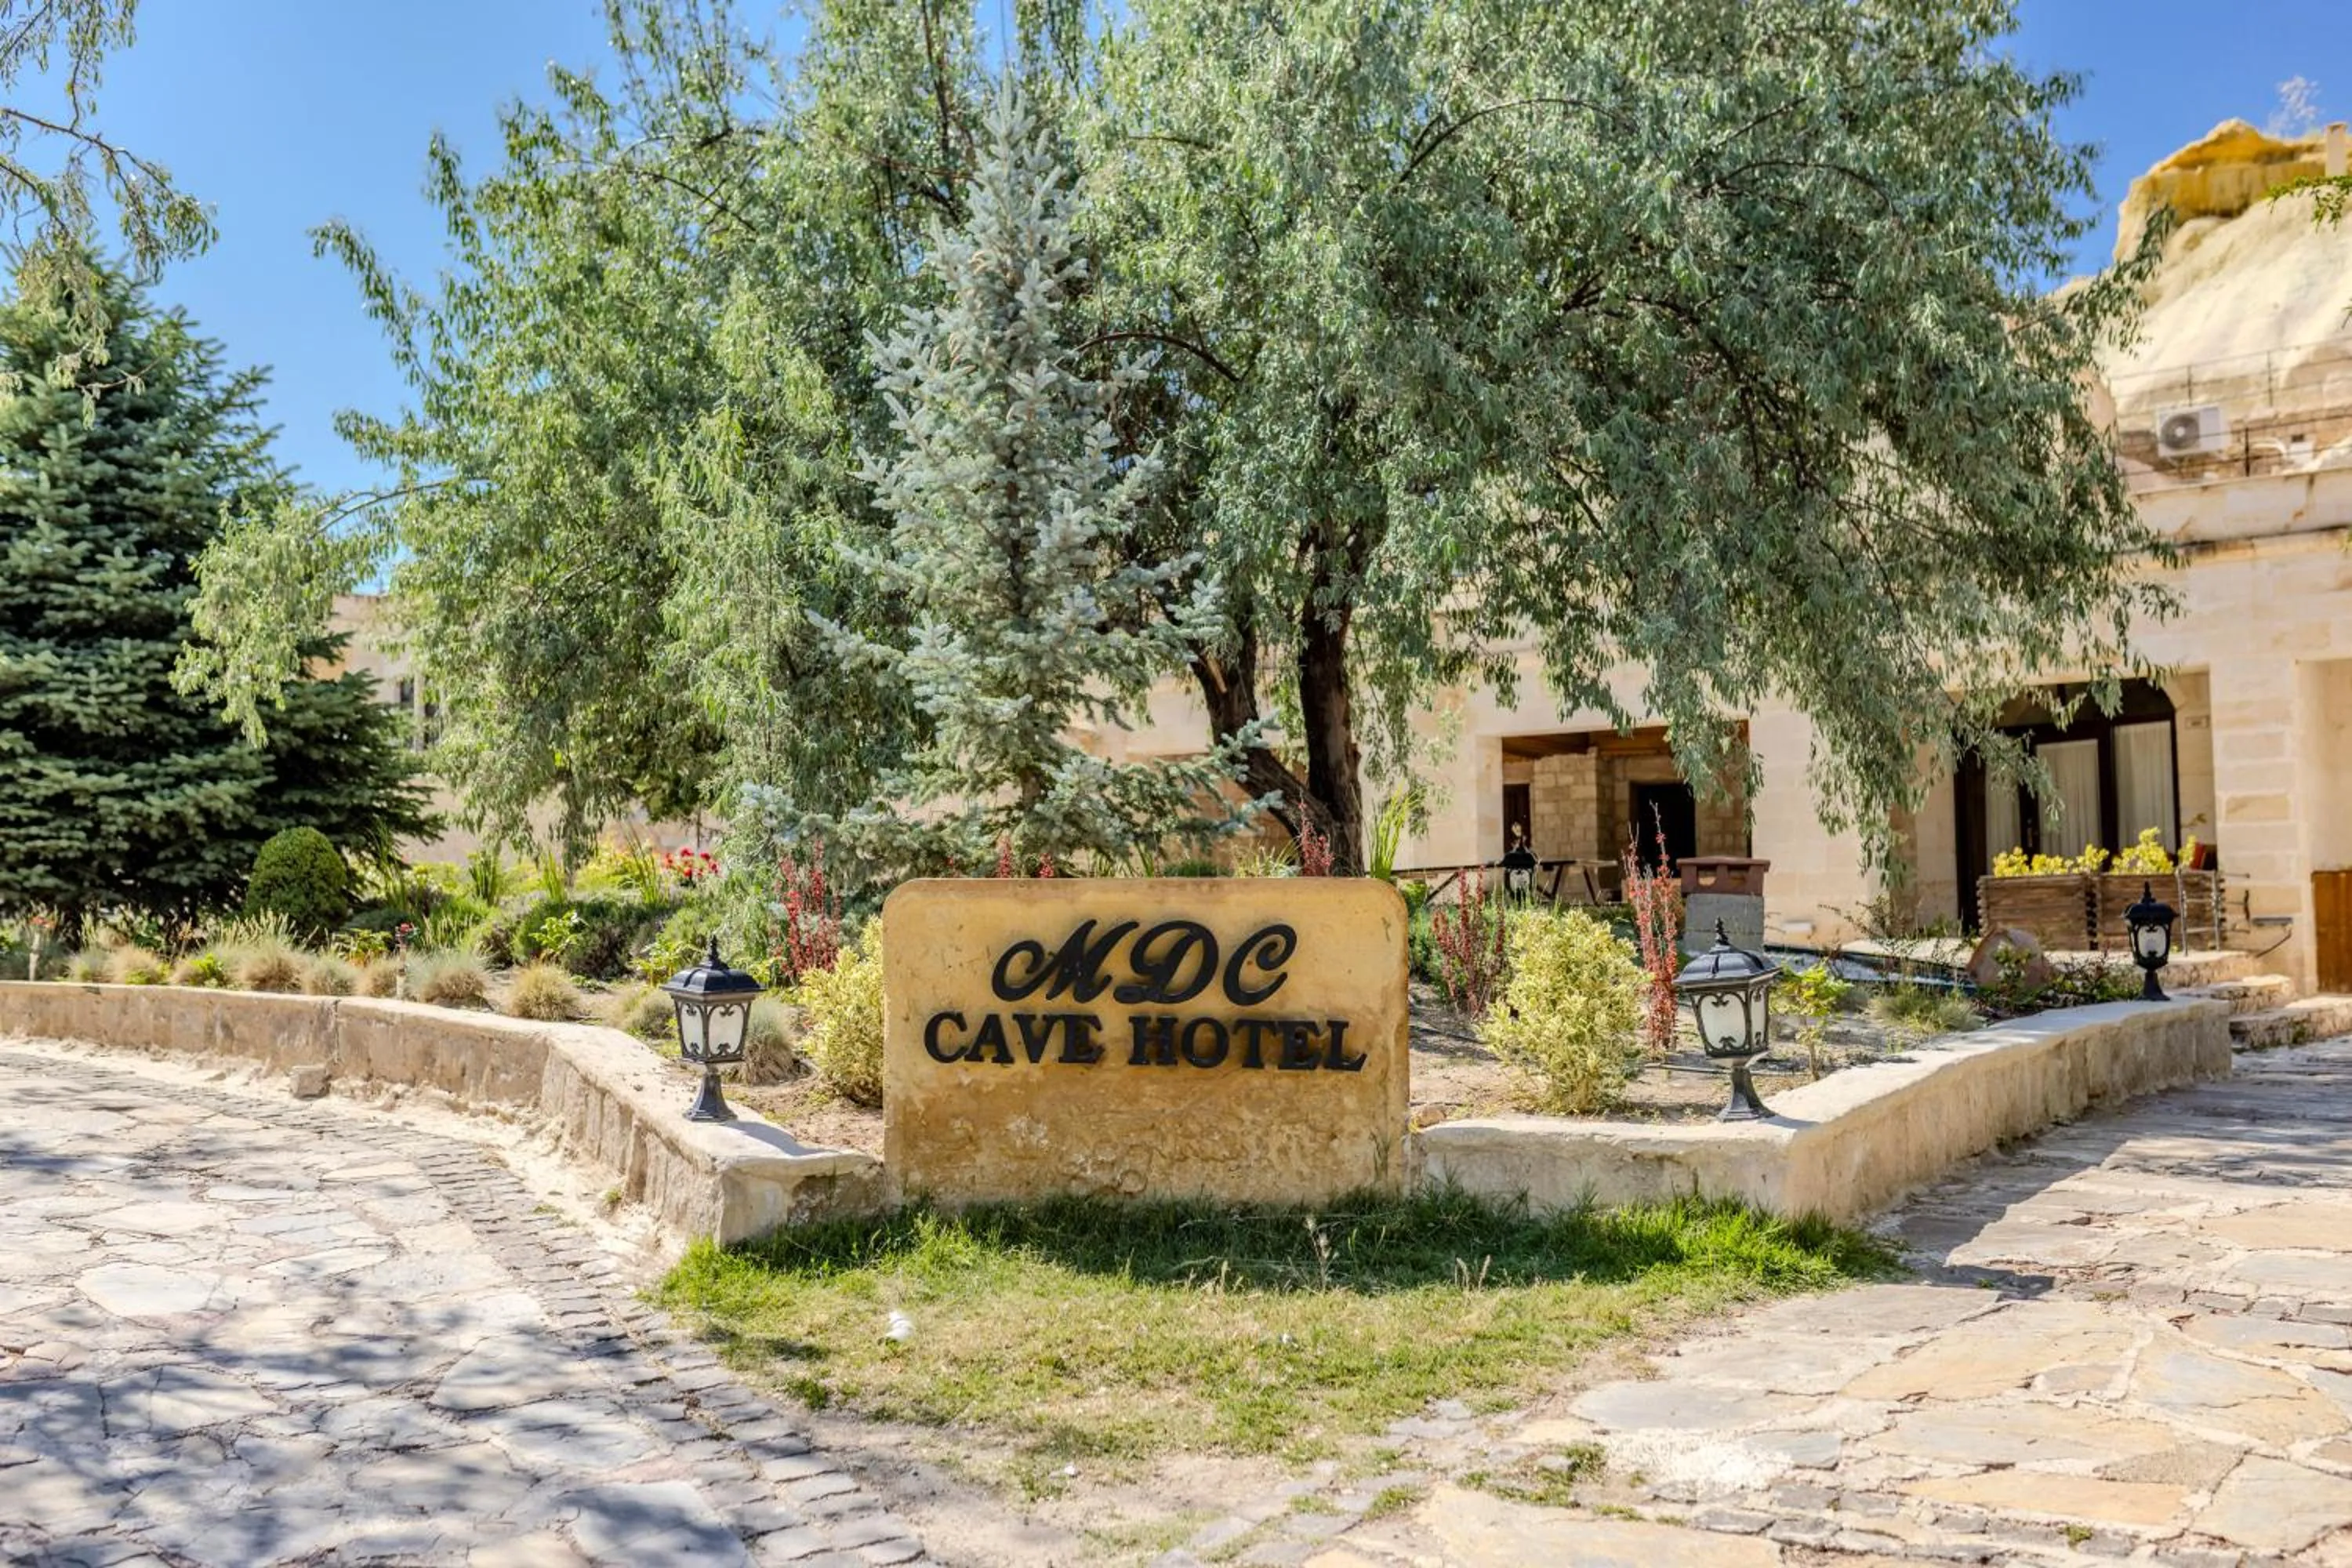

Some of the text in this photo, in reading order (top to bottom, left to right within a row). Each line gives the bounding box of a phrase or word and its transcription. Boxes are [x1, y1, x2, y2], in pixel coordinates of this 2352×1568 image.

[992, 919, 1298, 1007] MDC
[924, 1011, 1367, 1073] CAVE HOTEL
